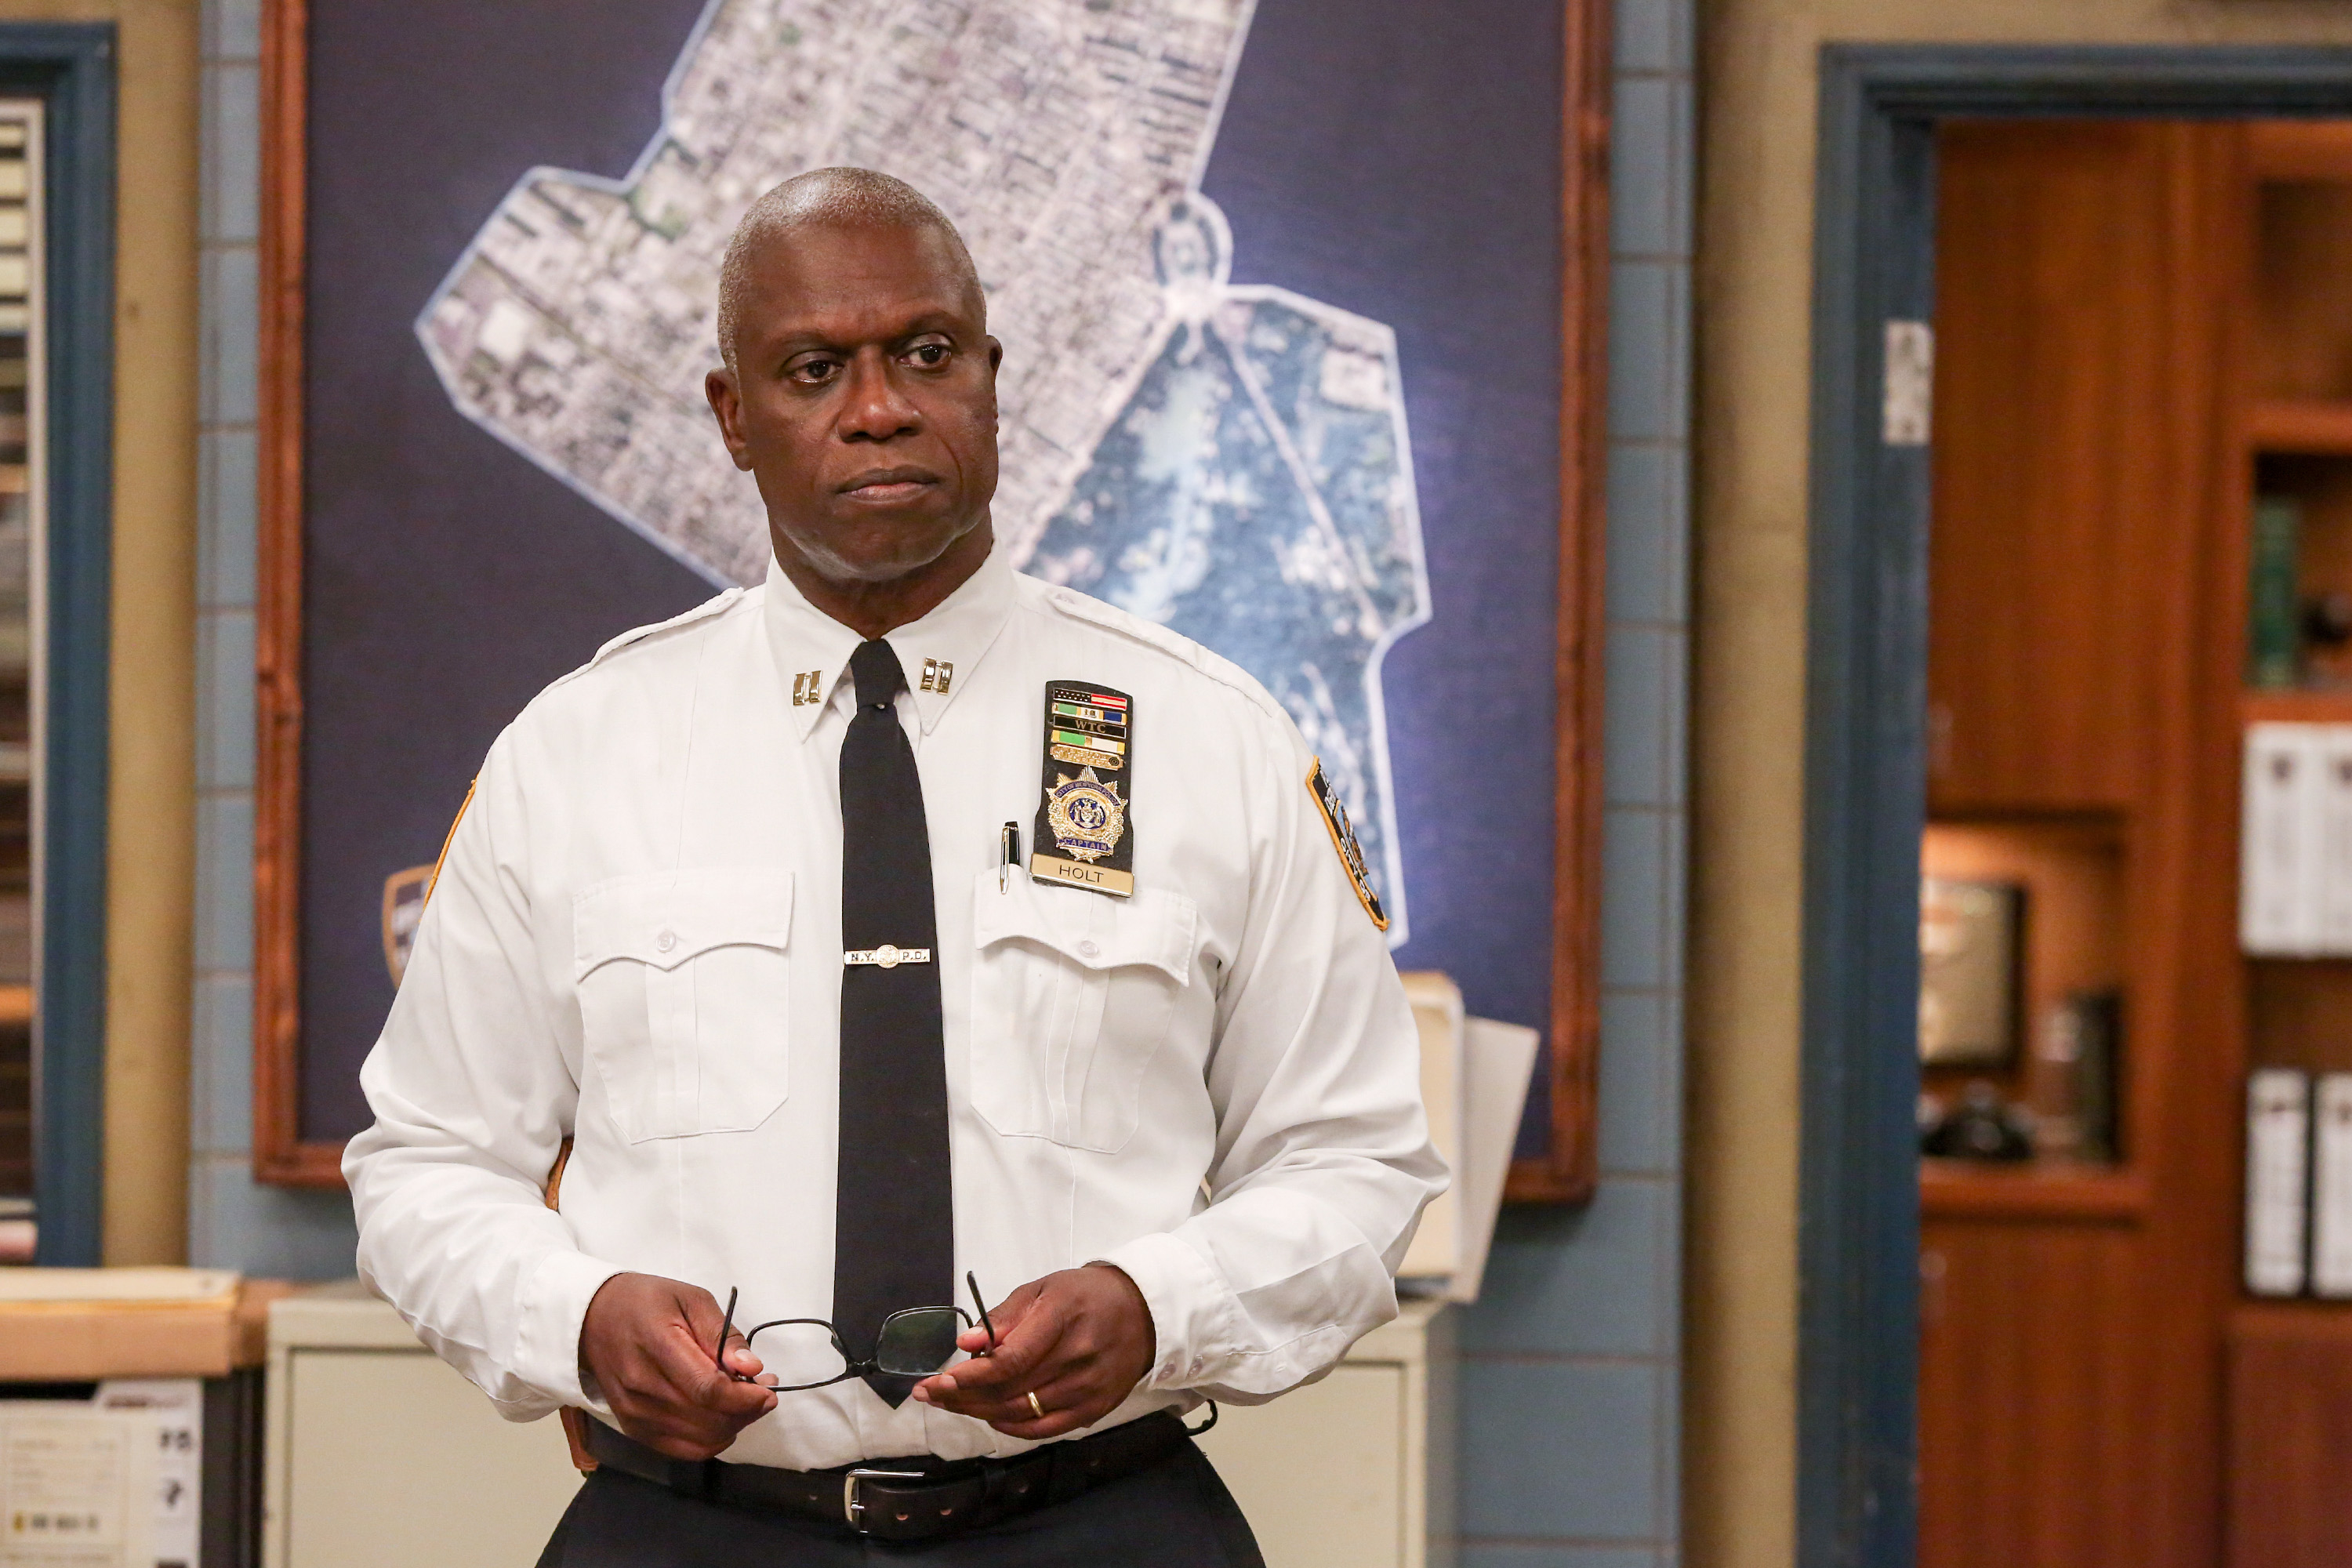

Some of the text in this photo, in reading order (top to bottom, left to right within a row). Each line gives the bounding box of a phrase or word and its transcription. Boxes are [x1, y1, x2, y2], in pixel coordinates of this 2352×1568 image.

[1075, 720, 1105, 733] WTC
[1055, 786, 1069, 797] CITY
[1087, 782, 1103, 791] YORK
[1101, 787, 1120, 805] POLICE
[1064, 838, 1107, 851] CAPTAIN
[1340, 837, 1359, 876] CITY
[1059, 865, 1104, 883] HOLT
[851, 951, 927, 962] N.Y. P.D.
